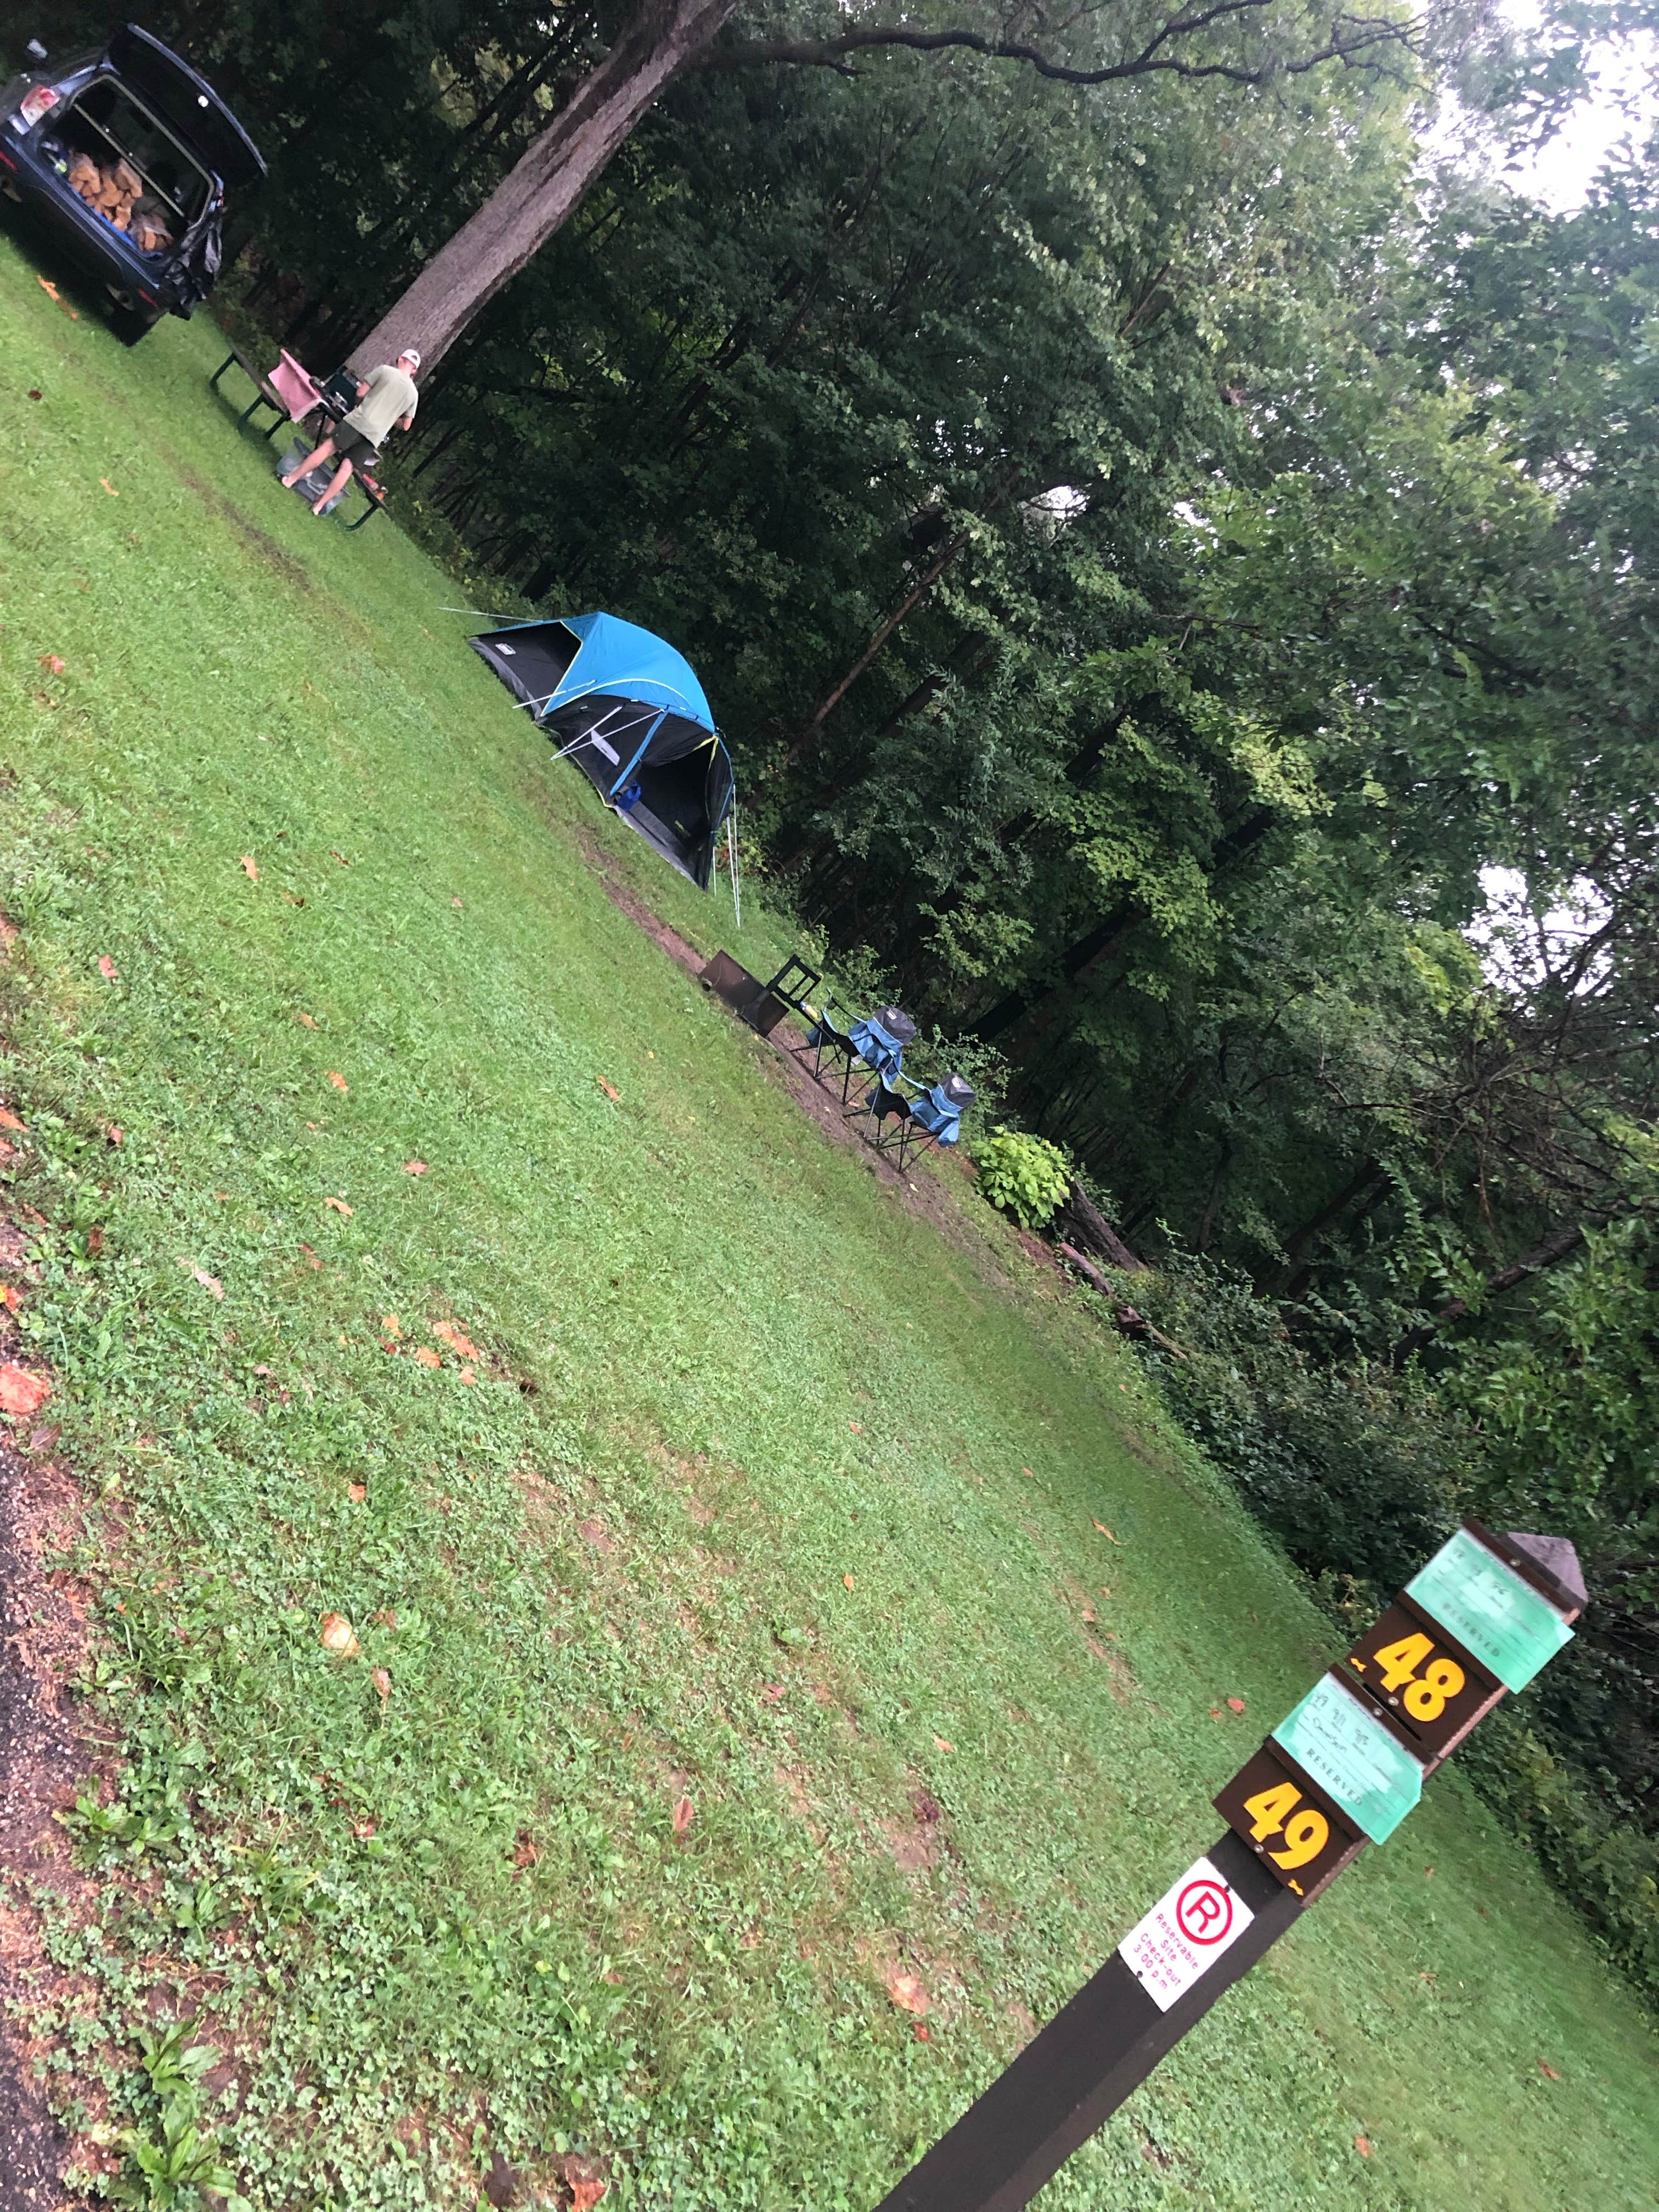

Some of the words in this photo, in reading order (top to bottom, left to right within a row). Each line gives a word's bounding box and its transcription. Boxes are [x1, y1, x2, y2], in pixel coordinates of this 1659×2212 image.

[1442, 1602, 1500, 1657] RESERVED
[1373, 1632, 1466, 1722] 48
[1306, 1747, 1363, 1806] RESERVED
[1243, 1781, 1330, 1870] 49
[1184, 1891, 1221, 1934] R
[1133, 1944, 1153, 1969] 3:00
[1140, 1933, 1182, 1986] Check-out
[1155, 1913, 1199, 1970] Reservable
[1160, 1939, 1177, 1961] Site
